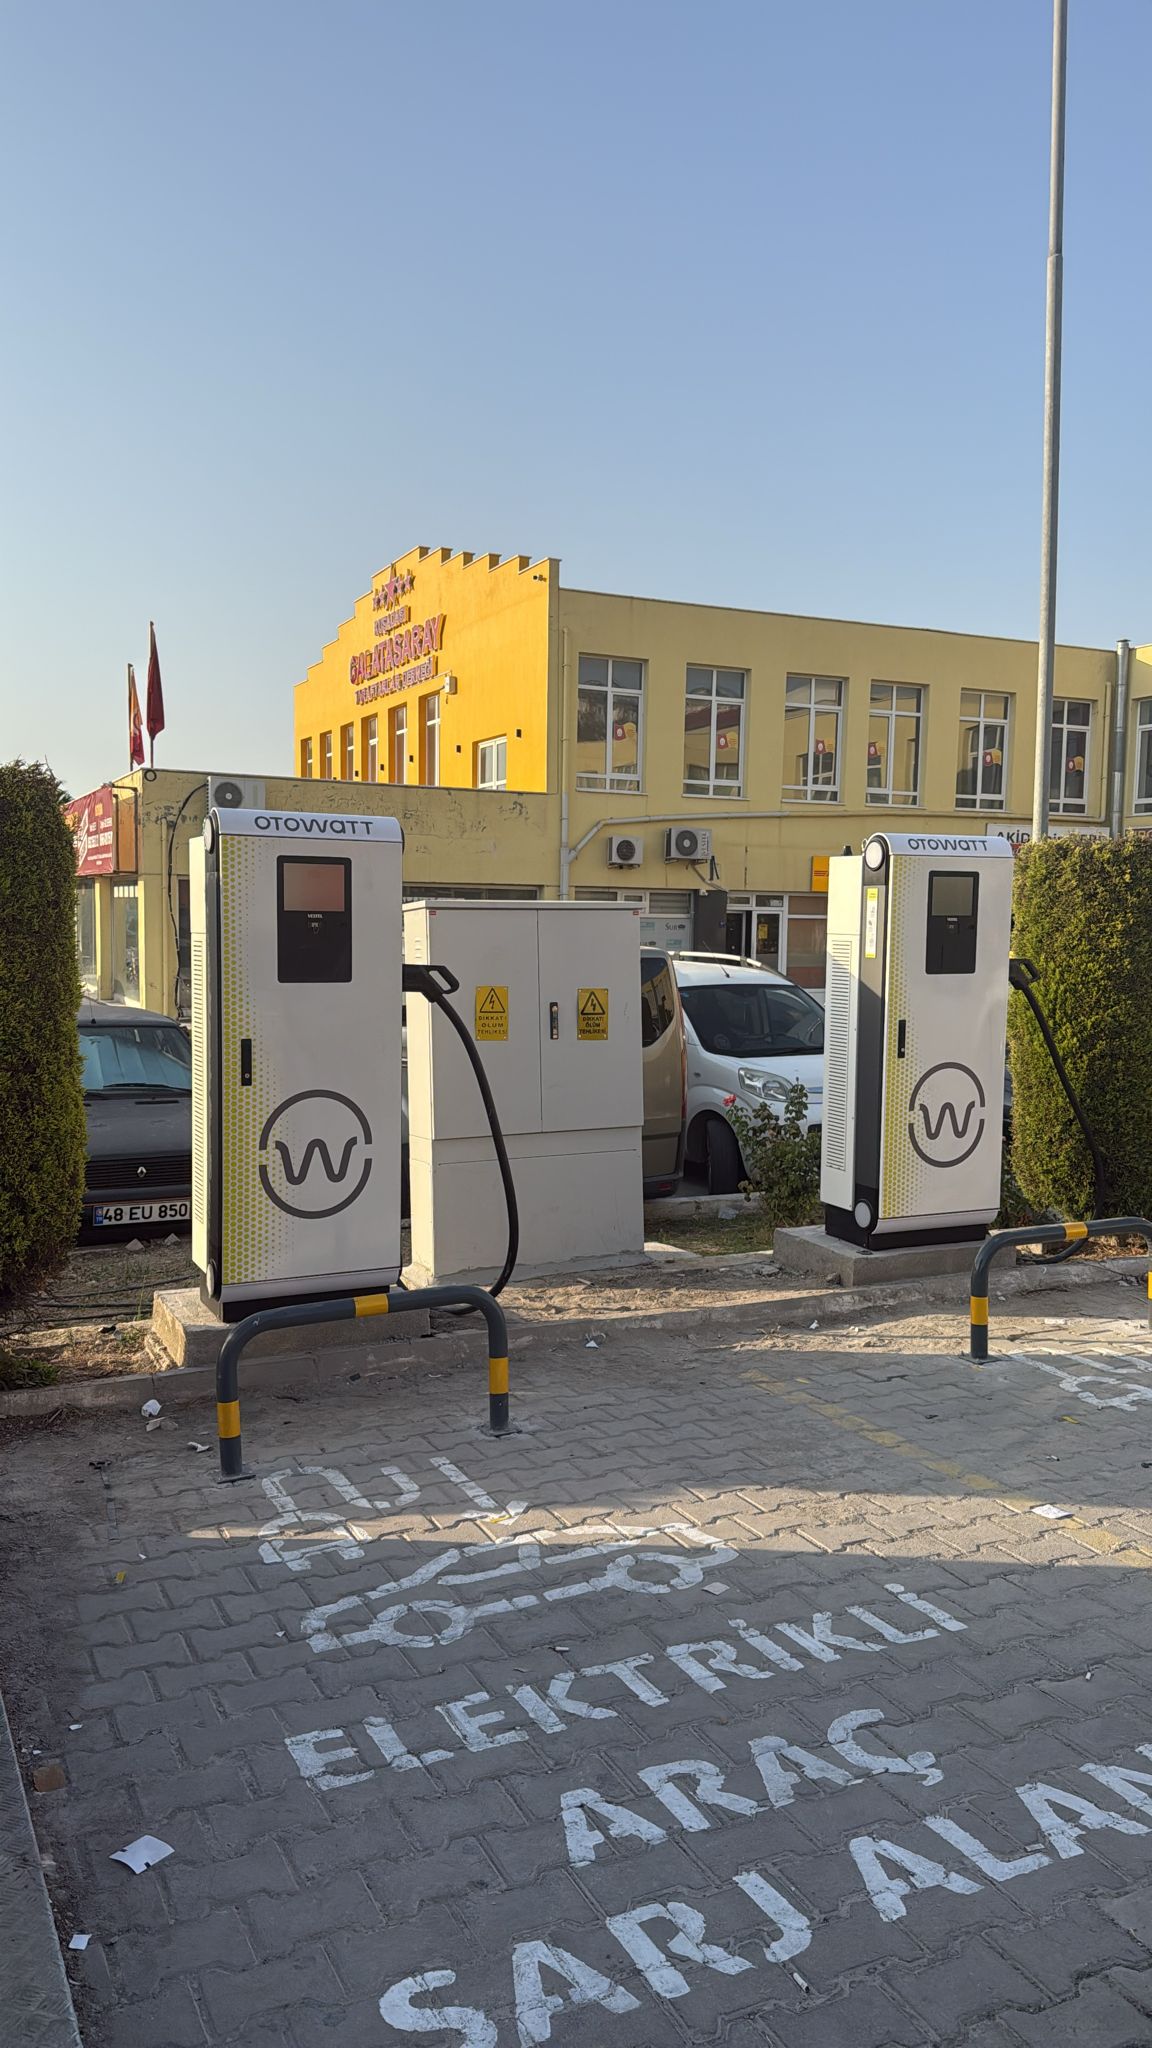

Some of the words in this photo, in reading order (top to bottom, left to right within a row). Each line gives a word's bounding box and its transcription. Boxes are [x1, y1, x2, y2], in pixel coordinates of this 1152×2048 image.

[350, 613, 446, 685] GALATASARAY
[103, 1207, 124, 1222] 48
[129, 1205, 153, 1220] EU
[158, 1203, 188, 1218] 850
[284, 1583, 968, 1790] ELEKTRİKLİ
[560, 1708, 944, 1866] ARAÇ
